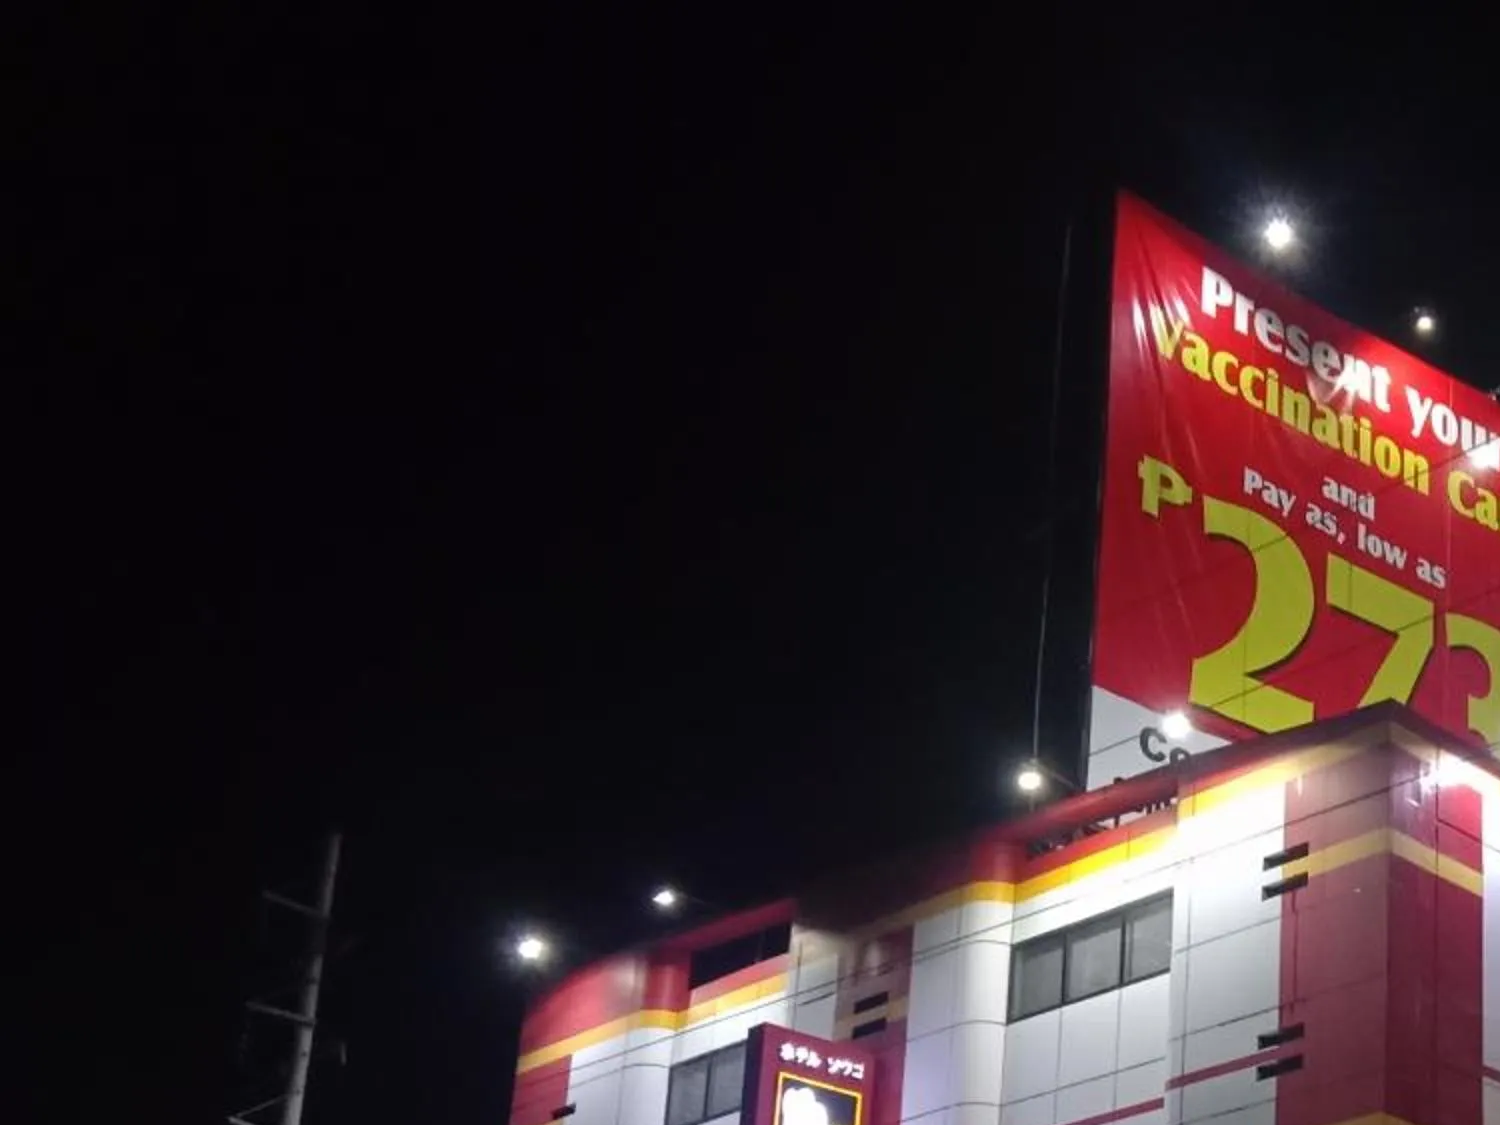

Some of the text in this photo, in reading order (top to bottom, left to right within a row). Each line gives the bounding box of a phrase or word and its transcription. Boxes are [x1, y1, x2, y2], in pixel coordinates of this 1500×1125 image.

[1150, 303, 1429, 496] Vaccination
[1202, 266, 1391, 413] Present
[1243, 466, 1296, 517] Pay
[1358, 524, 1407, 570] low
[1415, 557, 1446, 589] as
[1321, 476, 1376, 520] and
